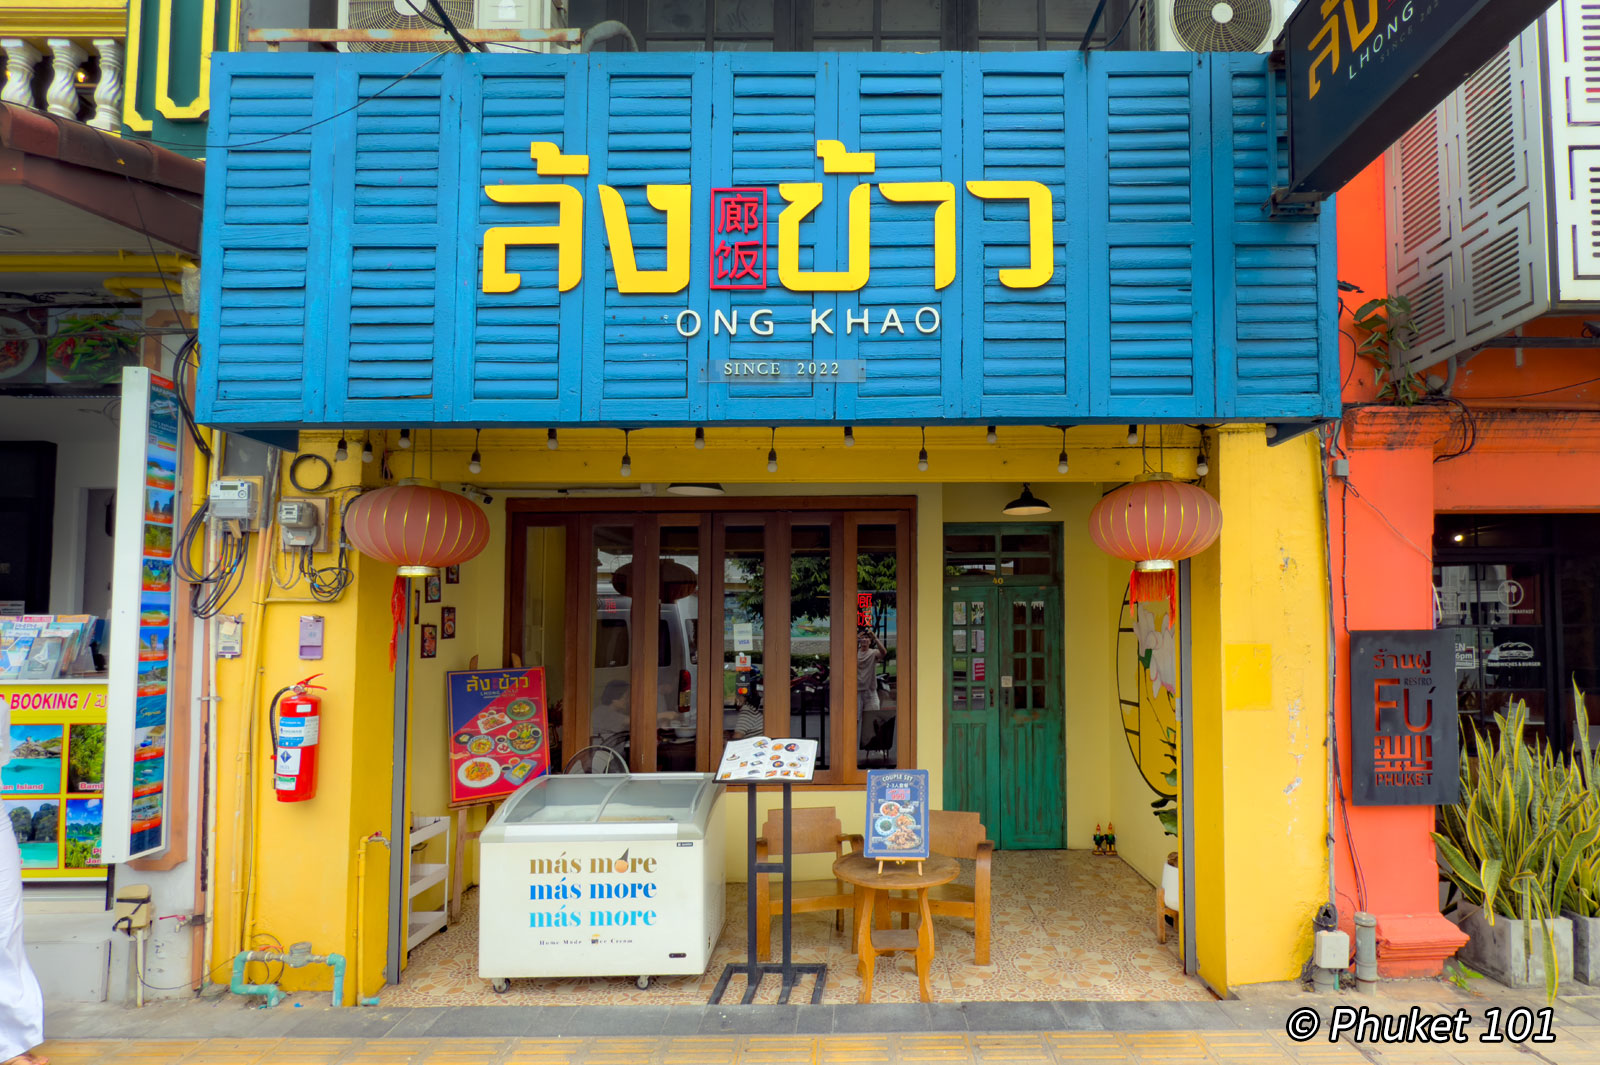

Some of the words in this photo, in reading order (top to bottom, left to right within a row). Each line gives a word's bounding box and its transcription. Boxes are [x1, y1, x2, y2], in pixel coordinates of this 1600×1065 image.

[1349, 0, 1414, 80] LHONG
[482, 140, 691, 294] ล้ง
[777, 139, 1054, 291] ข้าว
[715, 193, 760, 281] 廊饭
[676, 308, 775, 337] ONG
[810, 306, 941, 335] KHAO
[723, 362, 781, 377] SINCE
[796, 362, 840, 376] 2022
[1403, 677, 1433, 686] RESTRO
[10, 693, 78, 710] BOOKING
[882, 773, 902, 782] COUPLE
[1375, 773, 1433, 787] PHUKET
[529, 851, 582, 874] más
[529, 877, 582, 900] más
[589, 881, 657, 899] more
[529, 904, 582, 928] más
[589, 908, 657, 926] more
